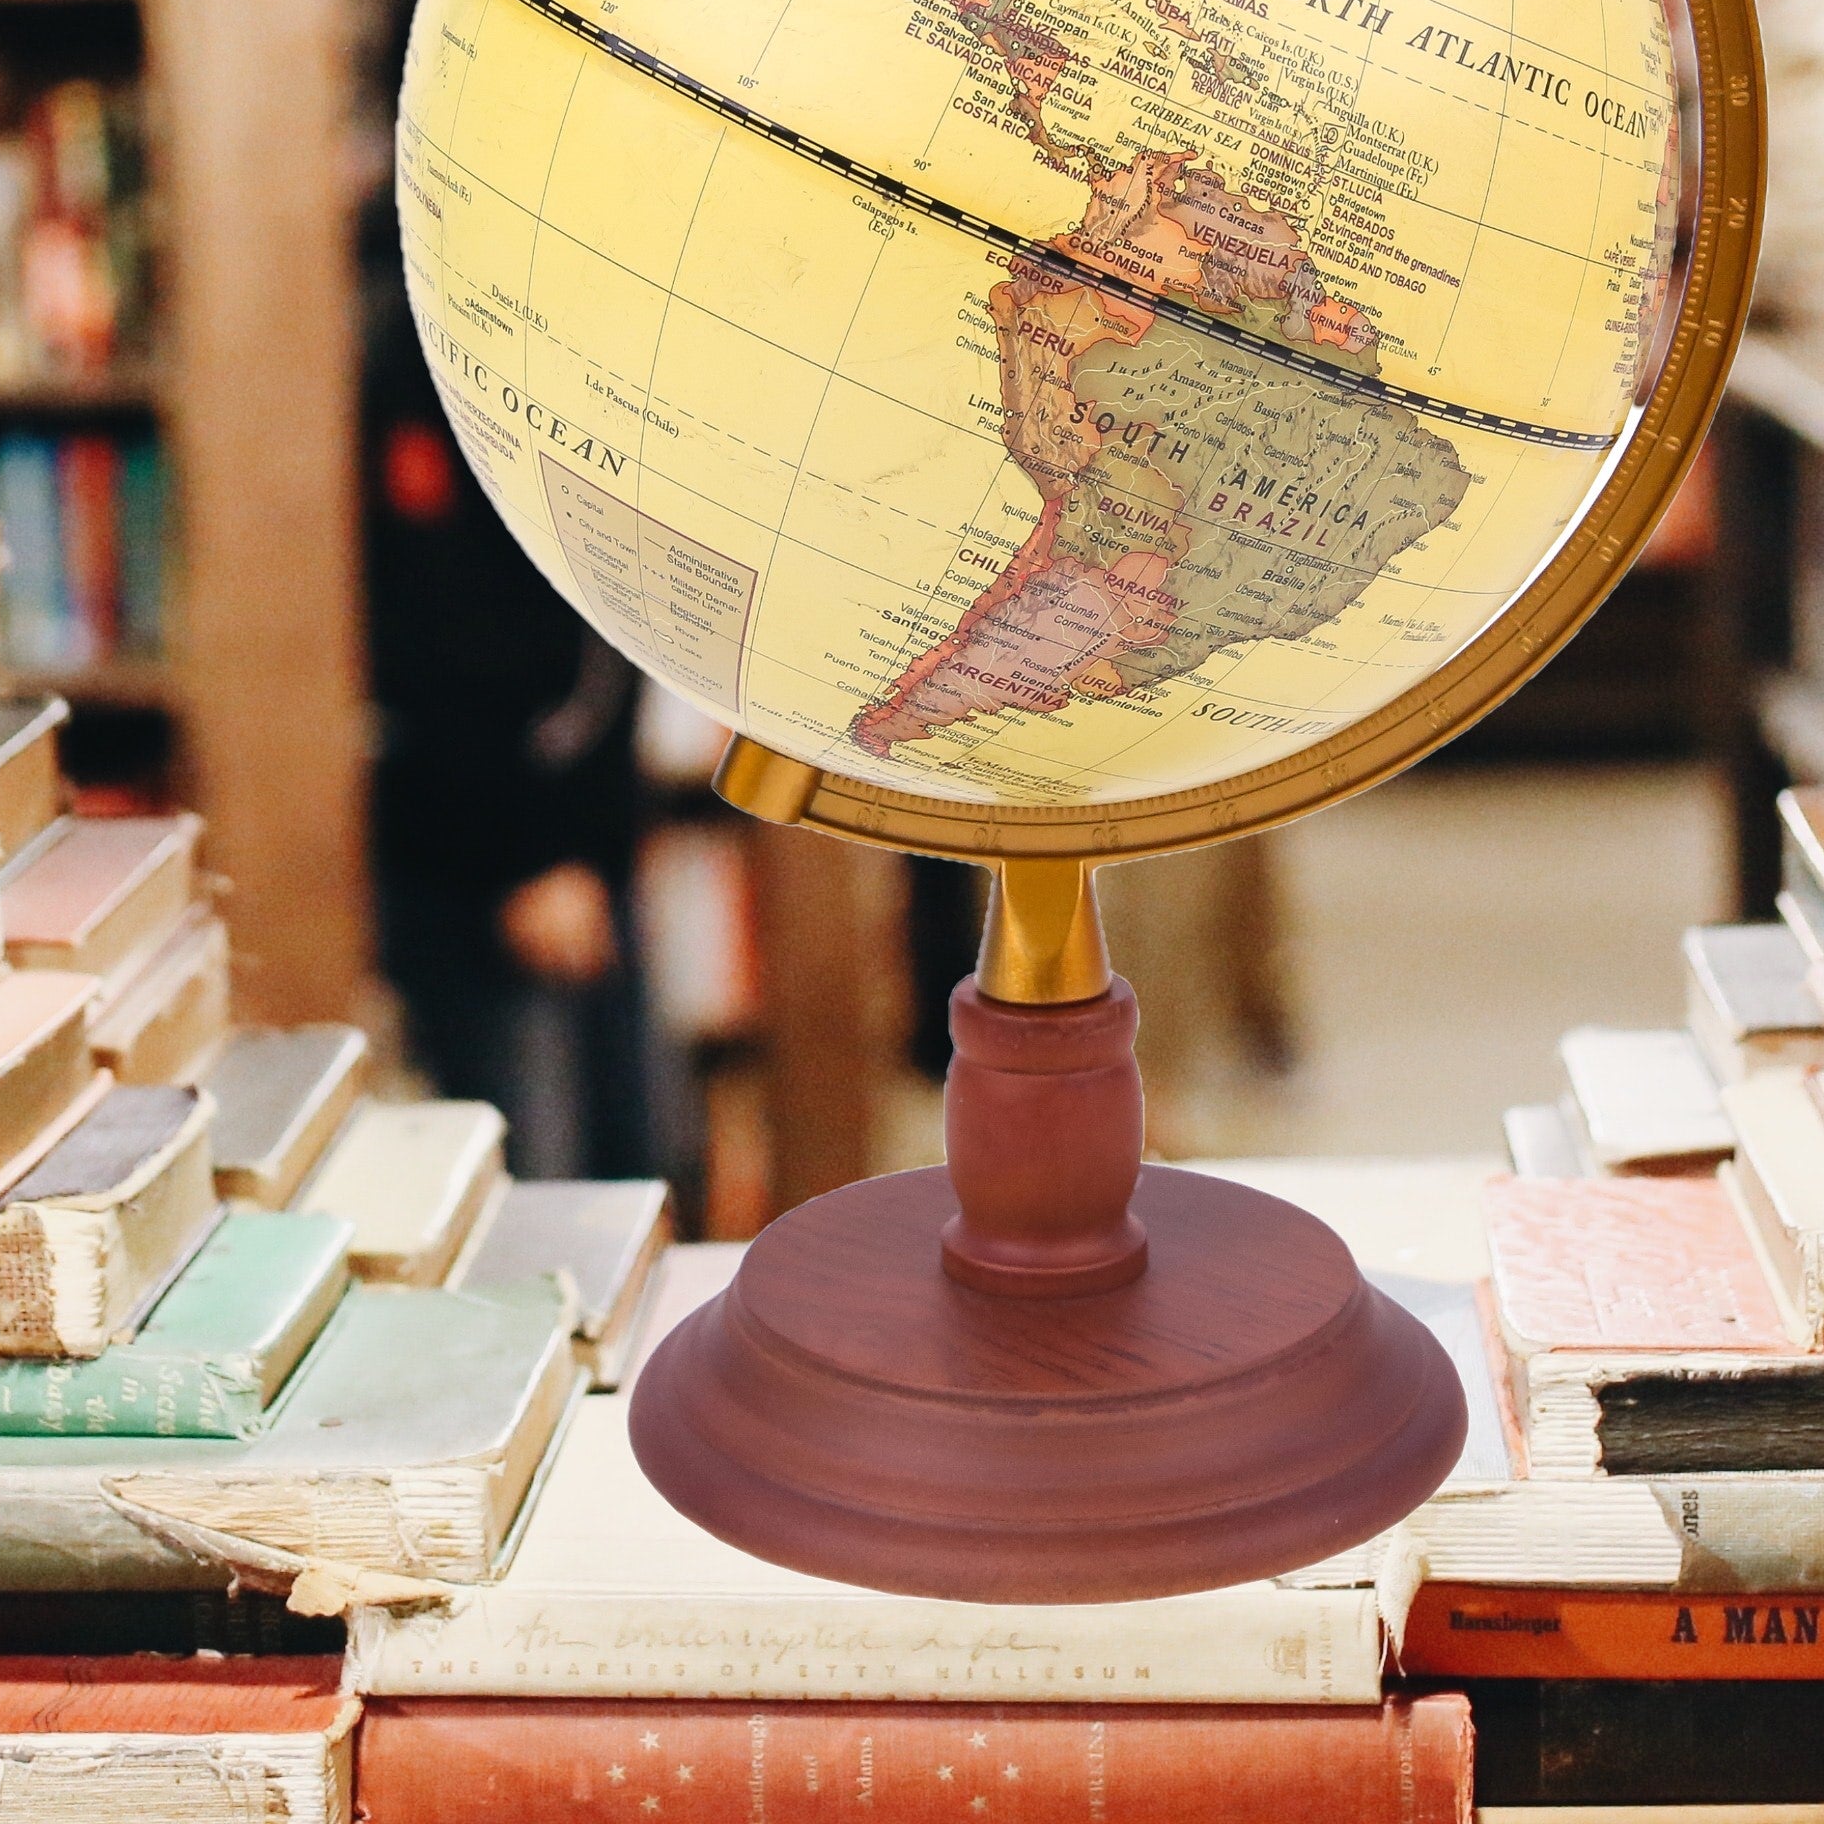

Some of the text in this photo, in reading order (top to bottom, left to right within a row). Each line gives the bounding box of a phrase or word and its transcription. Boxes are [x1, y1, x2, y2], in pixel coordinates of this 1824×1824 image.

[1410, 25, 1571, 104] ATLANTIC
[1584, 90, 1649, 140] OCEAN
[1192, 222, 1292, 270] VENEZUELA
[1018, 320, 1077, 359] PERU
[500, 387, 628, 477] OCEAN
[1068, 401, 1369, 531] SOUTH AMERICA
[1098, 495, 1177, 534] BOLIVIA
[1209, 492, 1328, 549] BRAZIL
[946, 660, 1067, 711] ARGENTINA
[1449, 1612, 1562, 1636] Harnsberger
[1671, 1612, 1697, 1642] A
[1724, 1610, 1820, 1644] MAN
